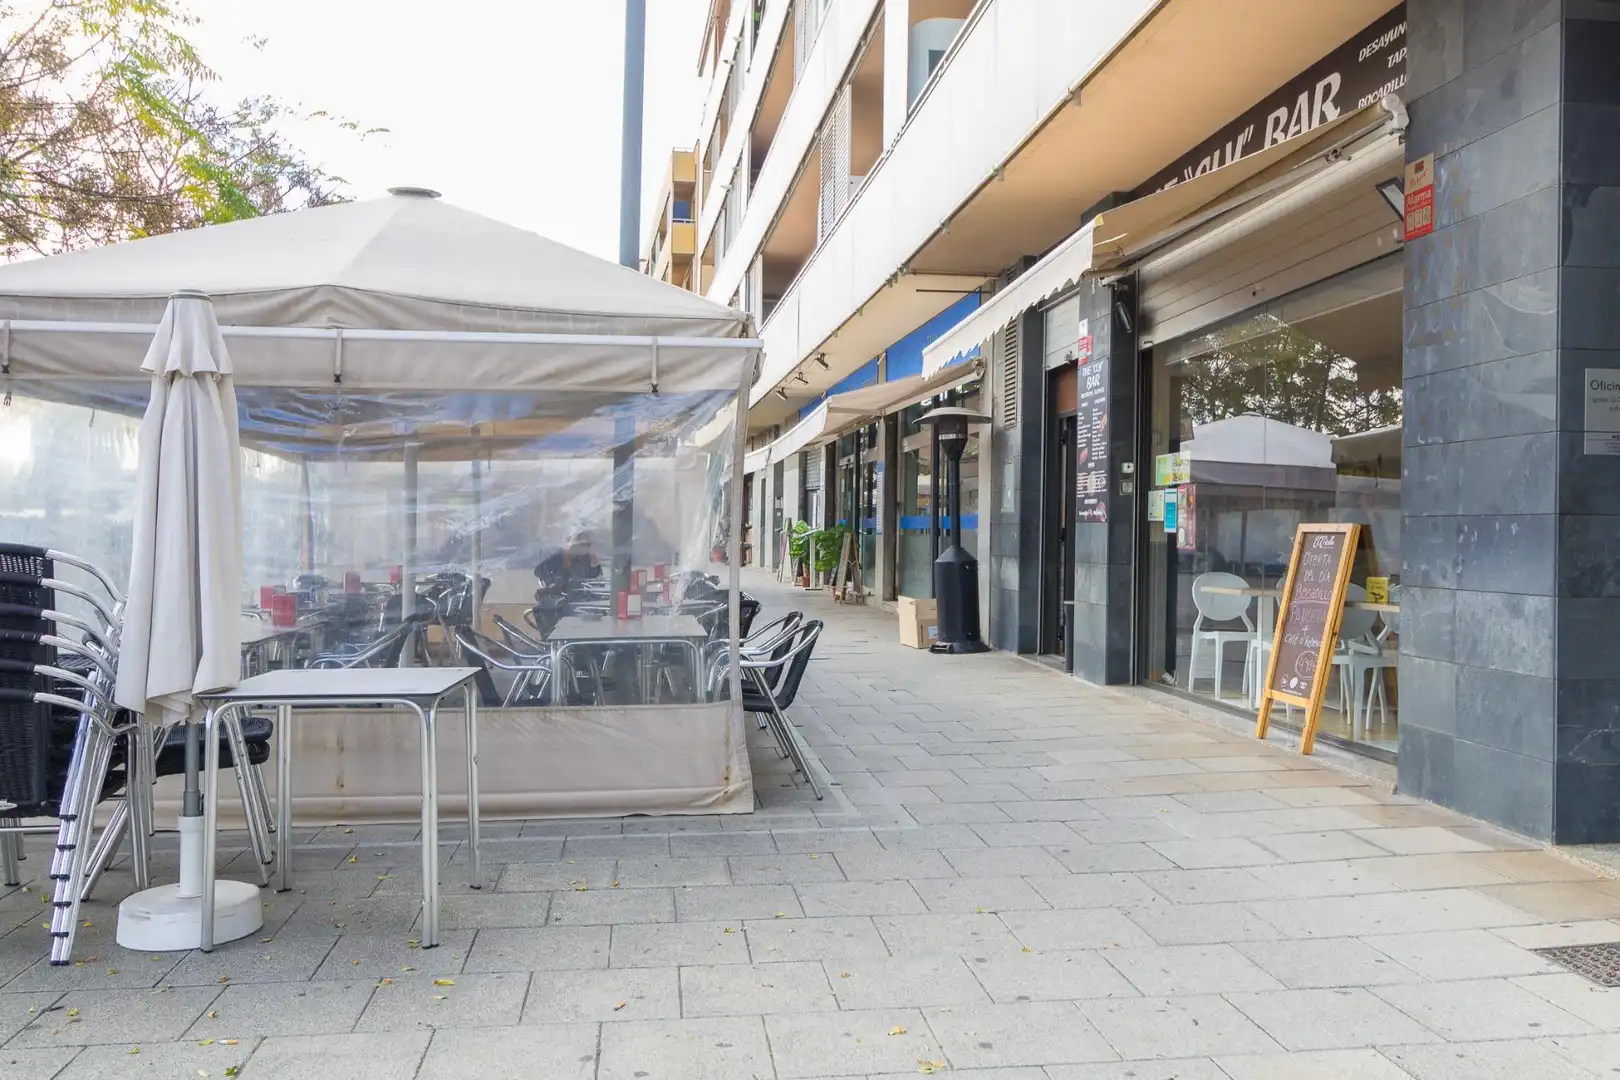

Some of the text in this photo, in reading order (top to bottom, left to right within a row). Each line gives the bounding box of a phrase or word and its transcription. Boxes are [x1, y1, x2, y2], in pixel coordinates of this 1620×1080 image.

[1358, 20, 1408, 63] DESAYUN
[1387, 46, 1408, 69] TAP
[1263, 71, 1342, 150] BAR
[1086, 373, 1101, 391] BAR
